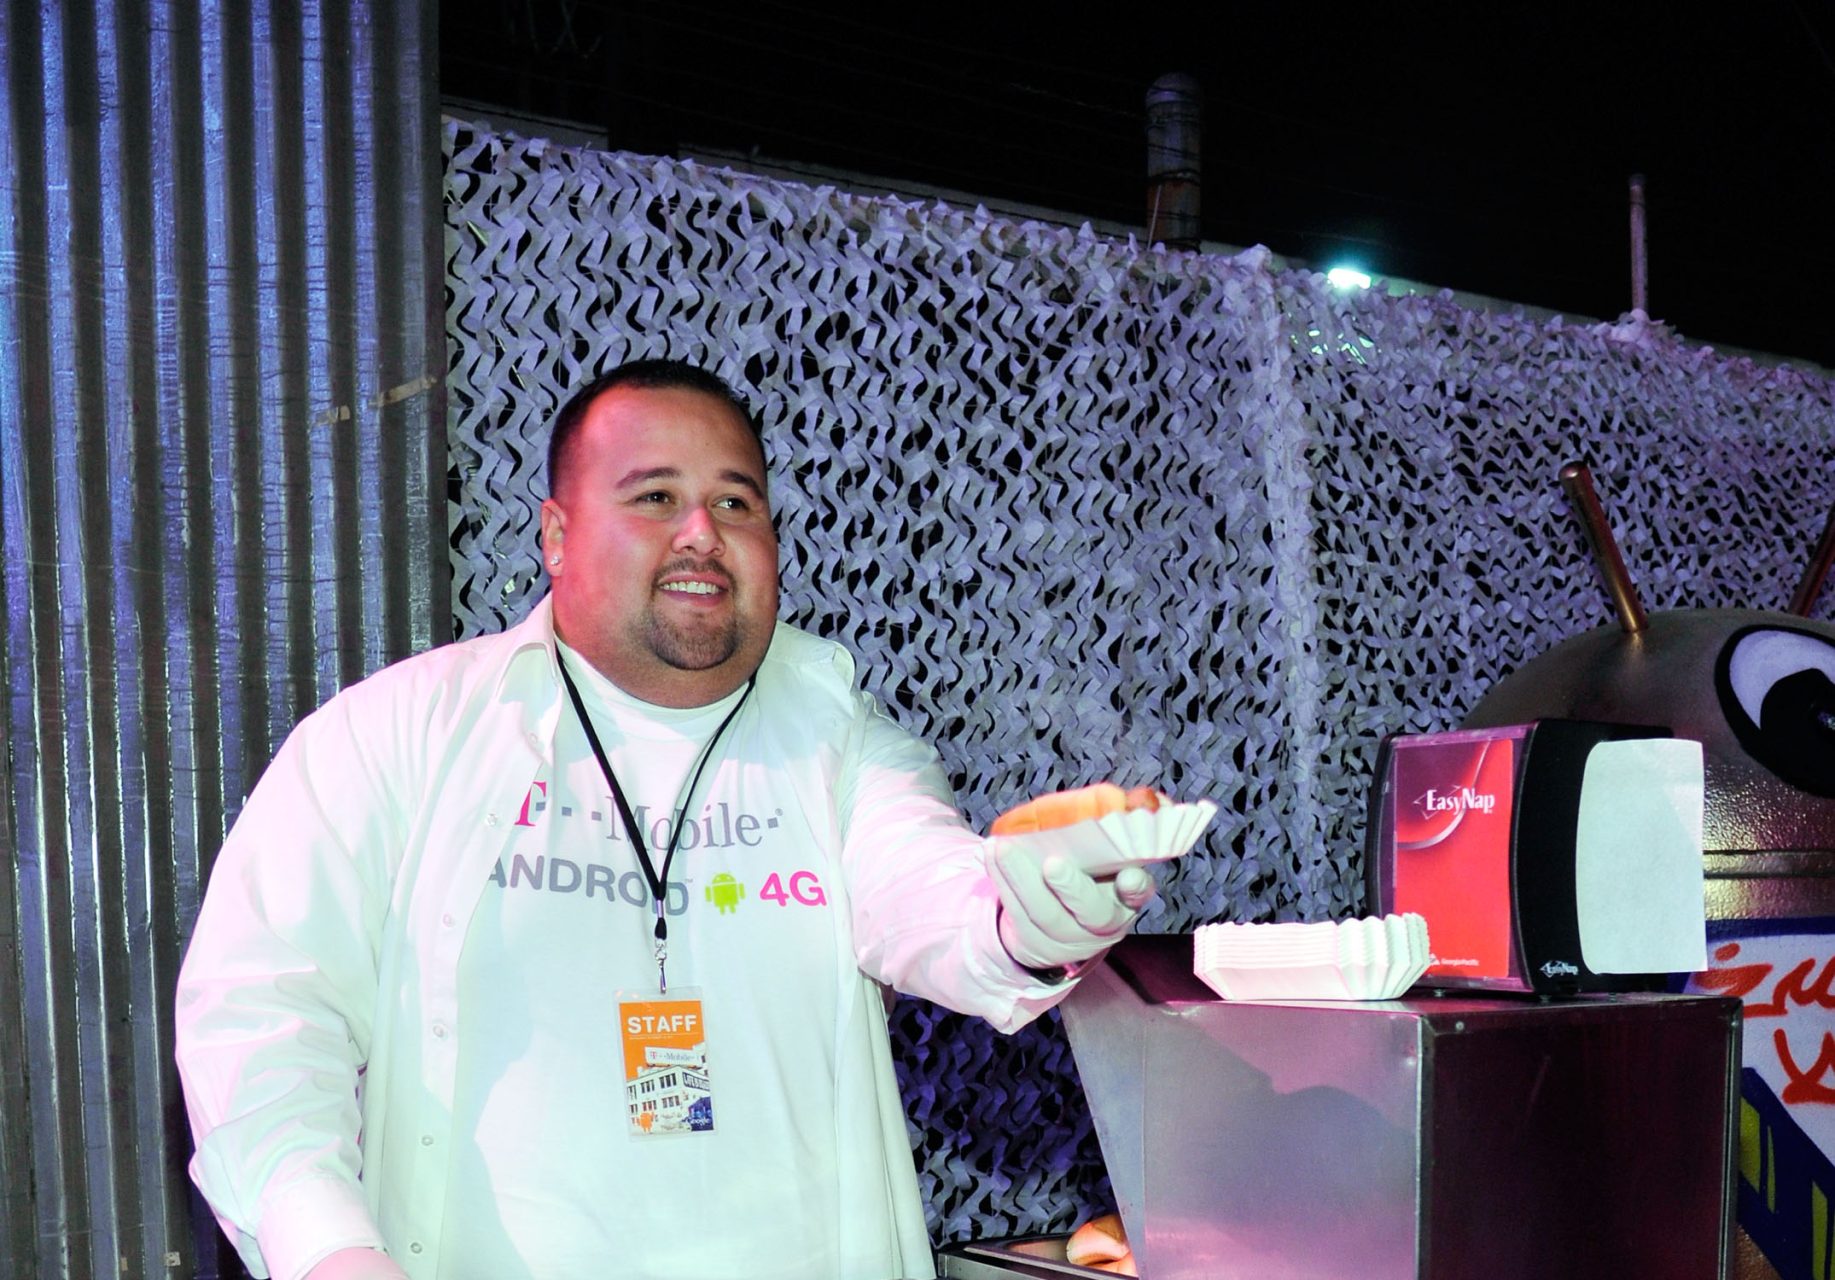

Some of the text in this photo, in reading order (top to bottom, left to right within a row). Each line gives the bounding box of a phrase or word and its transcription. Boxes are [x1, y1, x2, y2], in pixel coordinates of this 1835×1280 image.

[1426, 787, 1496, 815] EasyNap
[488, 853, 827, 917] ANDROD 4G
[627, 1015, 697, 1034] STAFF
